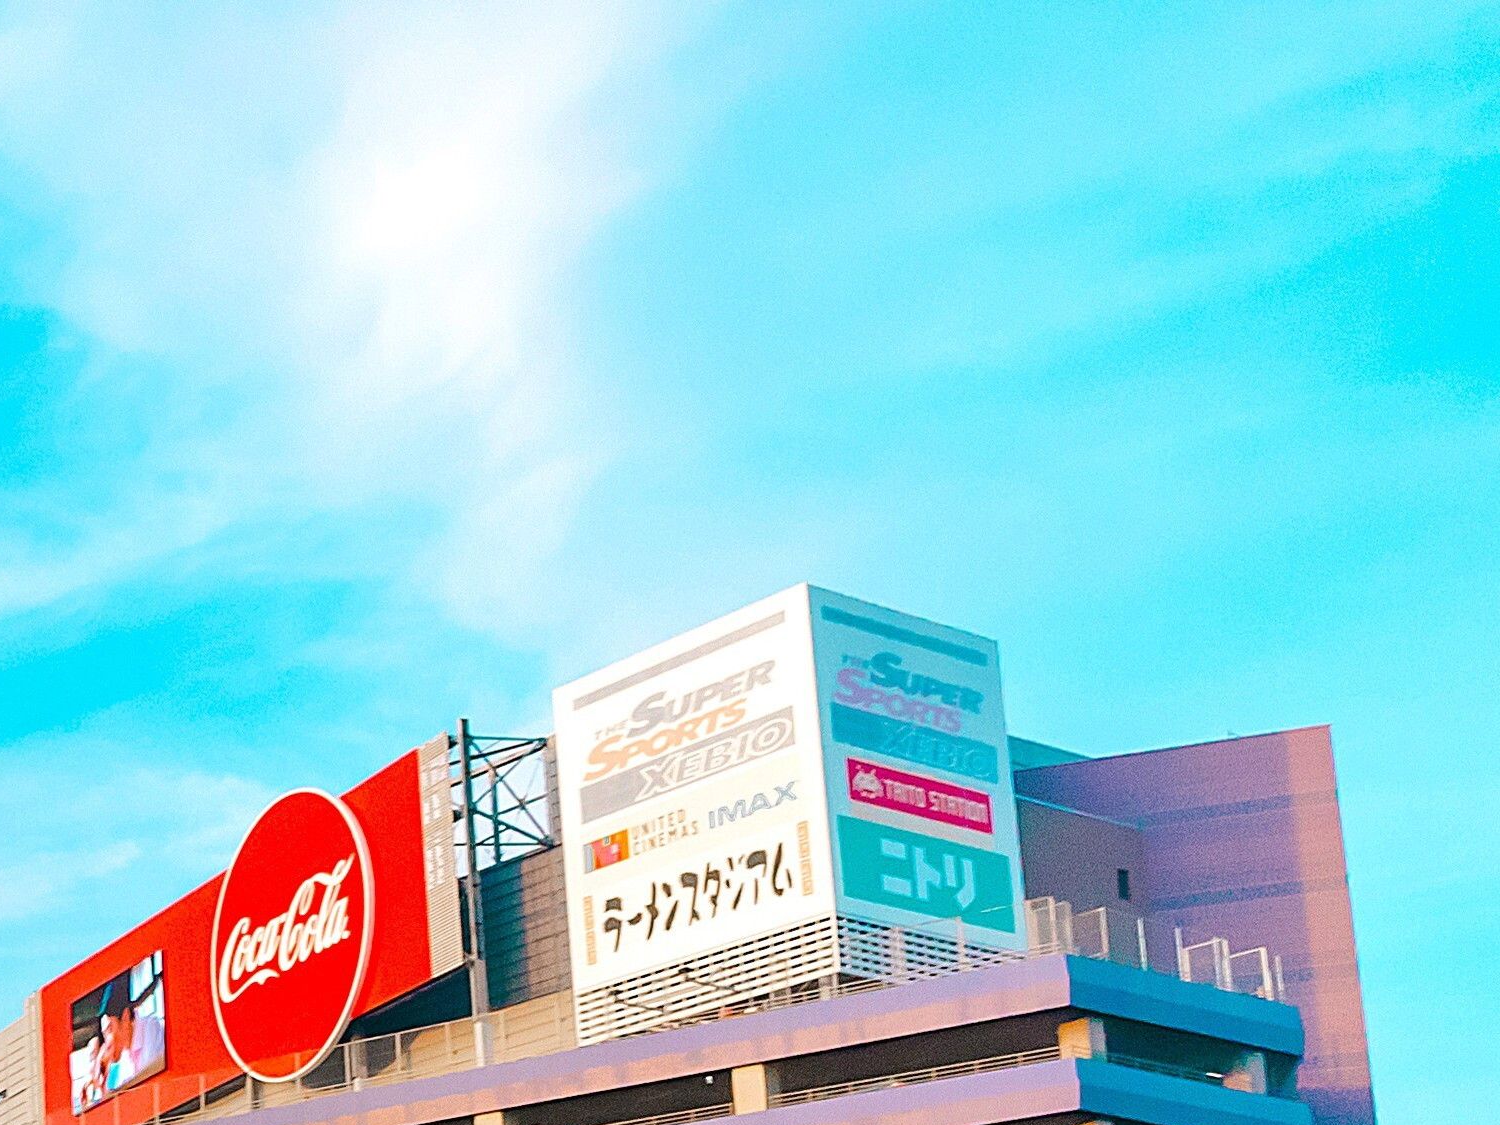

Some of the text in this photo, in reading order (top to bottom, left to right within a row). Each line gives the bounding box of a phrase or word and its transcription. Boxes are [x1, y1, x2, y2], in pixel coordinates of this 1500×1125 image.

[627, 660, 776, 738] SUPER
[834, 668, 963, 734] SPORTS
[870, 651, 984, 715] SUPER
[583, 698, 748, 782] SPORTS
[633, 718, 793, 802] XEBIO
[631, 809, 686, 841] UNITED
[632, 821, 699, 856] CINEMAS
[708, 781, 799, 829] IMAX
[603, 842, 793, 953] ラーメンスタジアム
[880, 838, 976, 909] ニトリ
